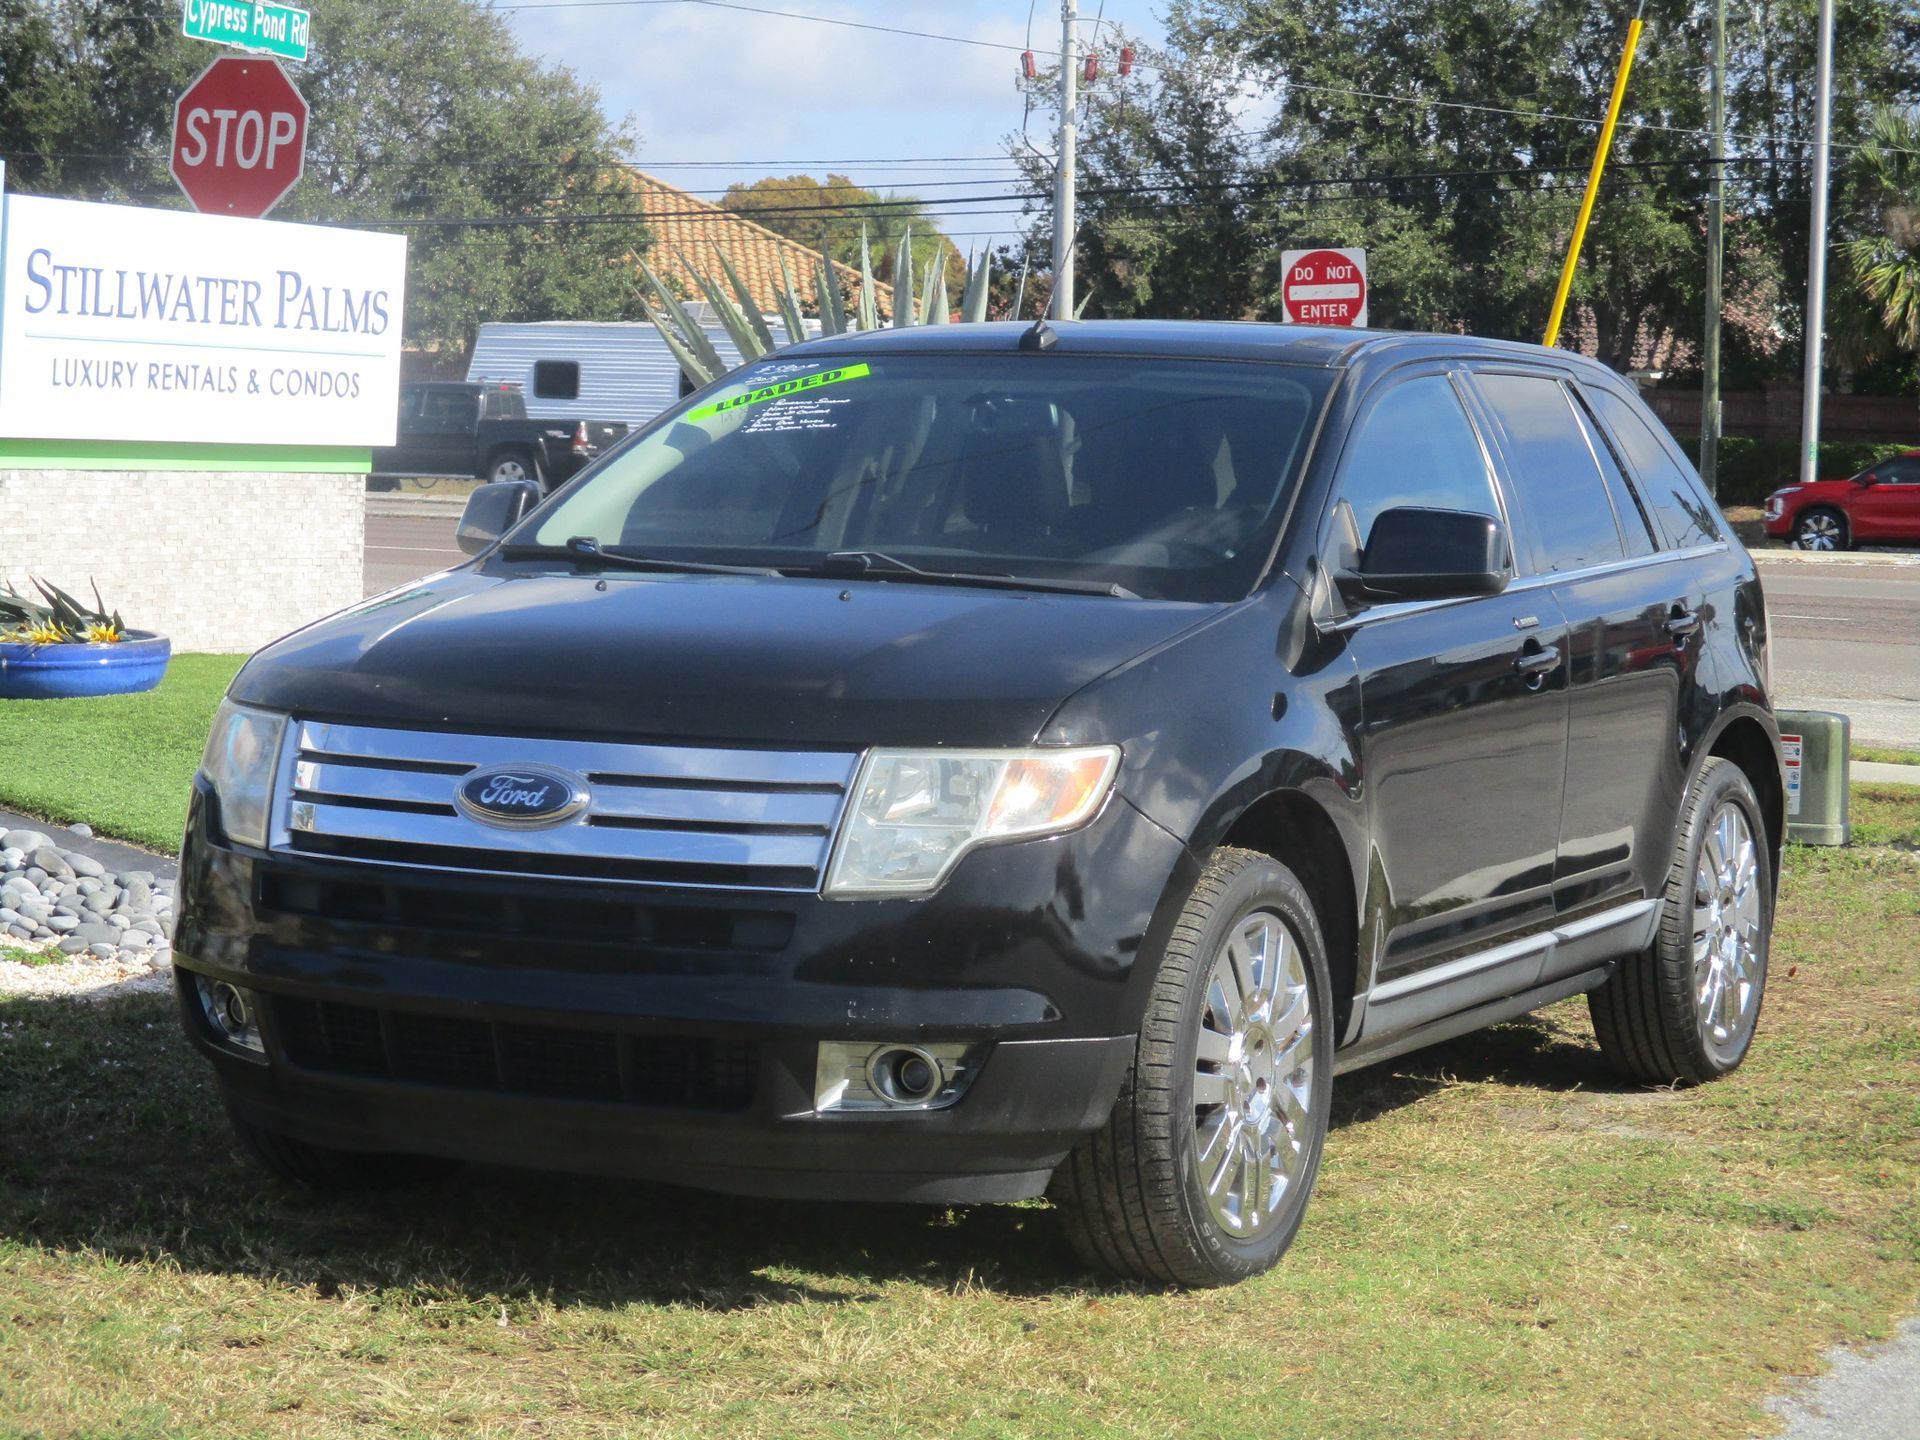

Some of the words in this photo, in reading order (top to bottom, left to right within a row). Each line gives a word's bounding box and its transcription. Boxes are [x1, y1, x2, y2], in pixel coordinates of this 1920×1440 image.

[188, 0, 247, 33] Cypress
[253, 5, 286, 41] Pond
[291, 13, 307, 46] Rd
[181, 107, 297, 170] STOP
[25, 248, 262, 327] STILLWATER
[273, 270, 389, 335] PALMS
[1295, 267, 1314, 280] DO
[1326, 265, 1353, 279] NOT
[1301, 304, 1348, 318] ENTER
[52, 357, 138, 389] LUXURY
[148, 362, 238, 394] RENTALS
[247, 369, 260, 394] &
[270, 368, 360, 399] CONDOS
[715, 369, 844, 412] LOADED
[480, 775, 550, 807] Ford
